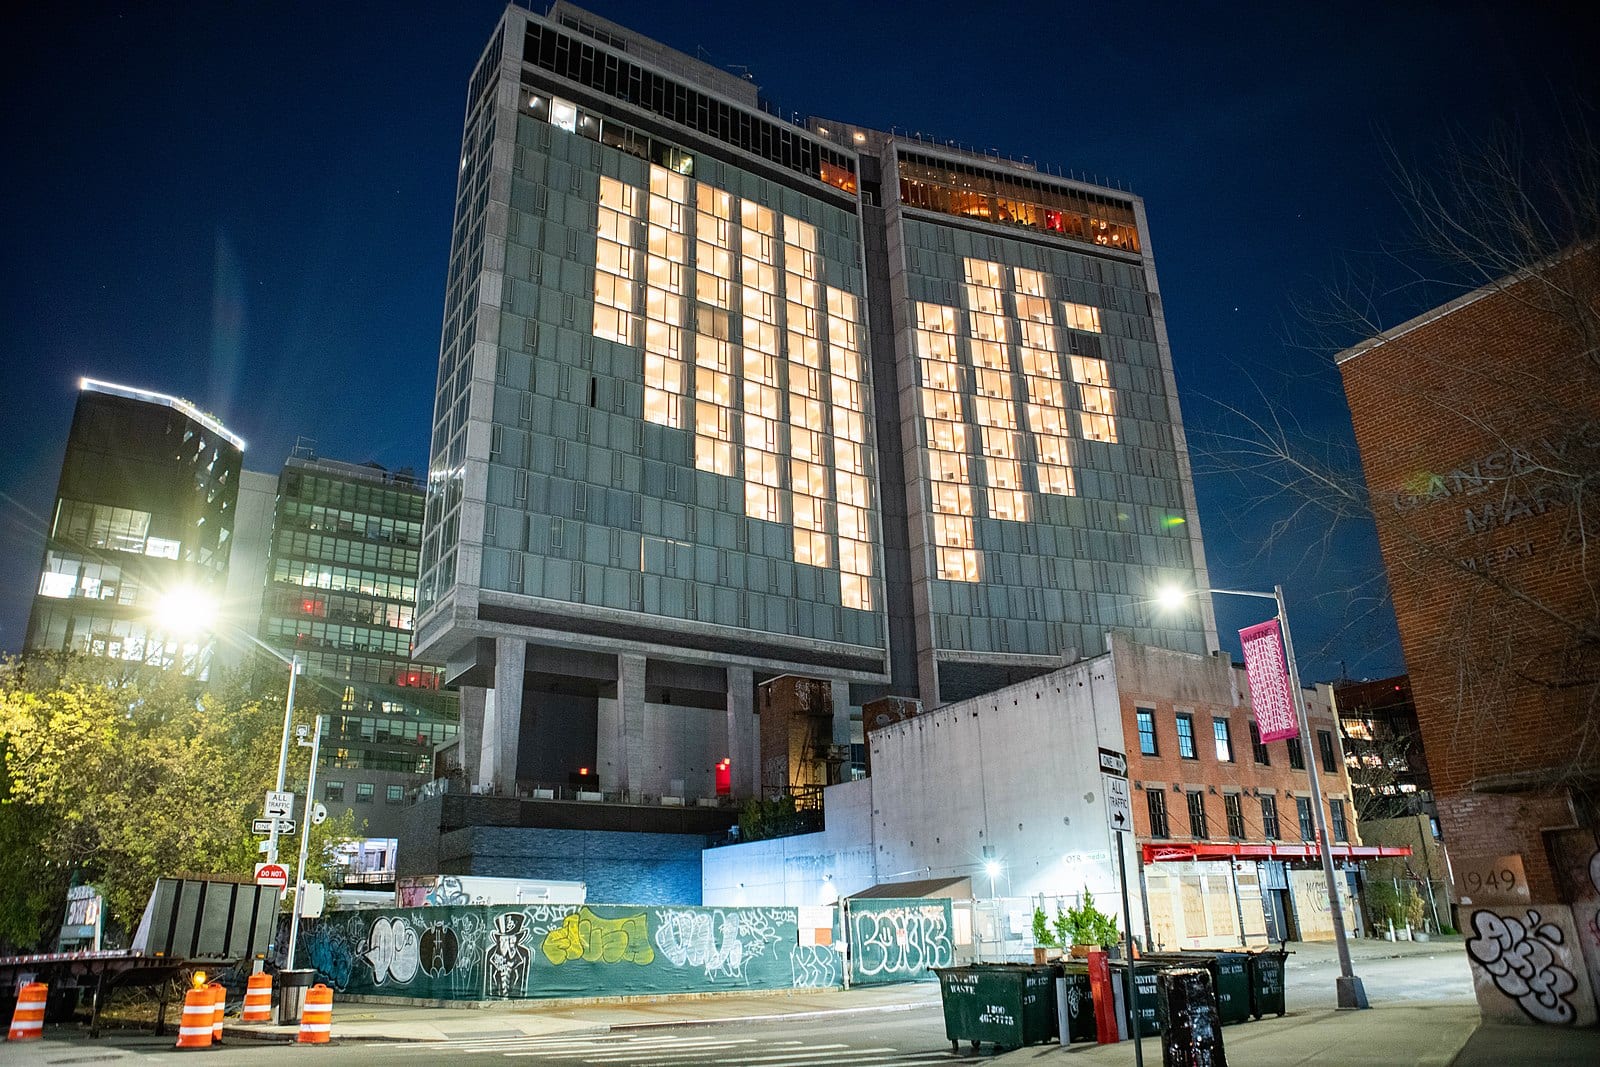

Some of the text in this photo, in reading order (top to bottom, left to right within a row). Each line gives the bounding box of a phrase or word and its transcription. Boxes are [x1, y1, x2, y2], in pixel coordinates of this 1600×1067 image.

[1260, 719, 1293, 734] WHITNEY
[1102, 755, 1113, 767] ONE
[1111, 781, 1123, 795] ALL
[1109, 796, 1128, 809] TRAFFIC
[1461, 869, 1515, 893] 1949
[1134, 975, 1158, 984] CENTUR
[950, 985, 976, 995] WASTE
[1138, 985, 1157, 994] WASTE
[986, 1005, 1006, 1015] 1800
